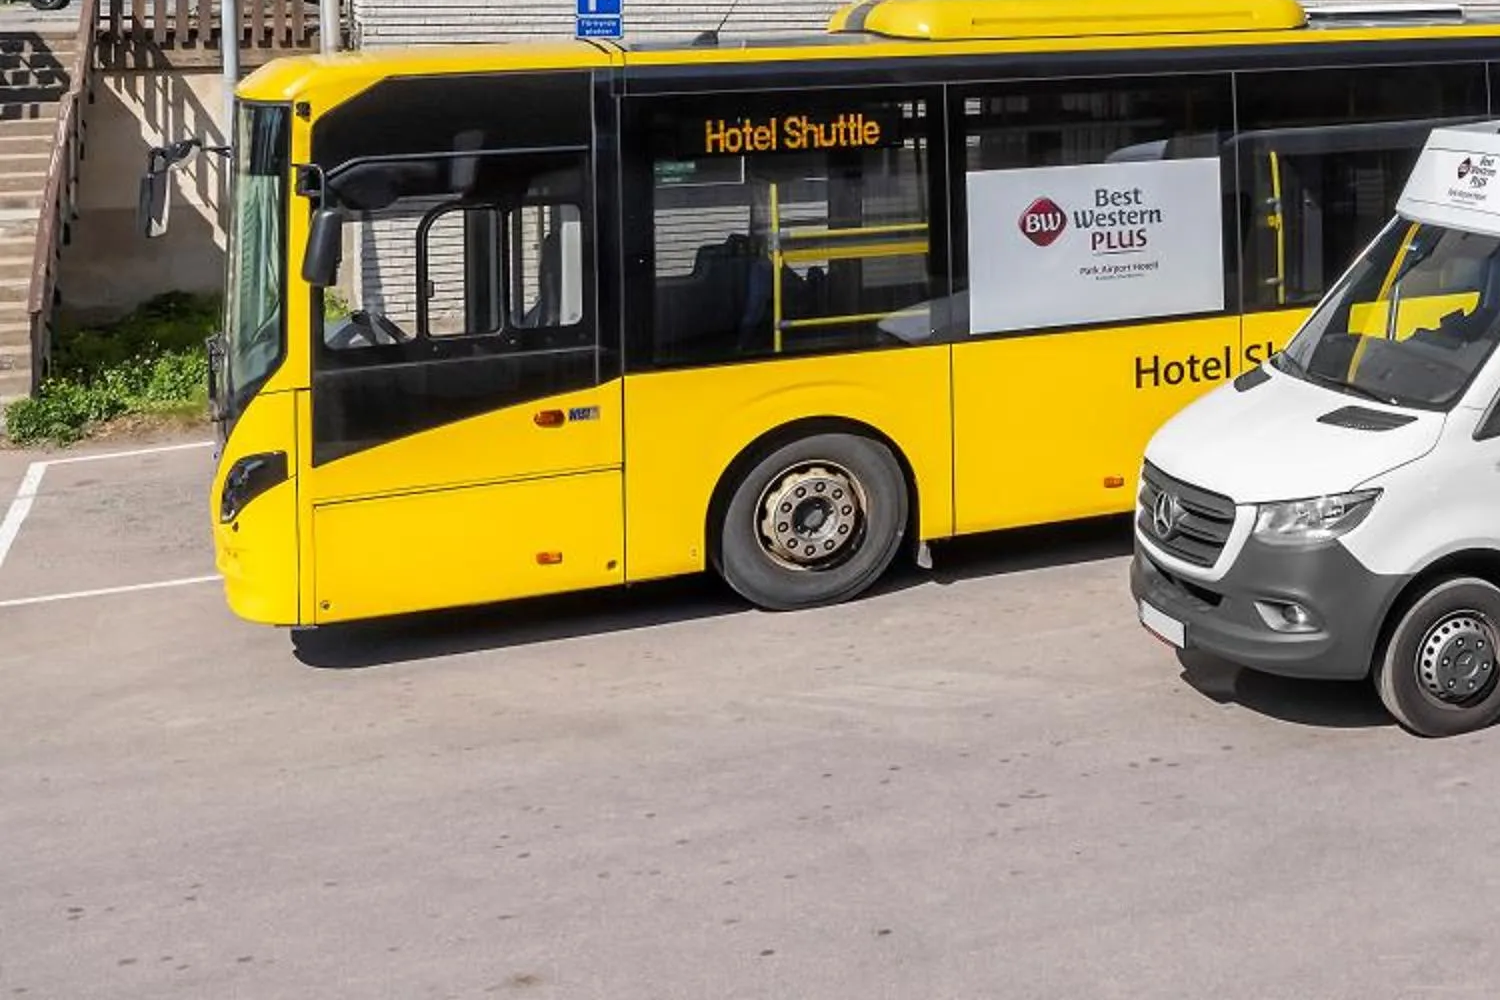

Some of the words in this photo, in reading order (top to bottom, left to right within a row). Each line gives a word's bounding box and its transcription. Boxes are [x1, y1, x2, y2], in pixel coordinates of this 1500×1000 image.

[706, 117, 777, 153] Hotel
[784, 113, 881, 149] Shuttle
[1095, 187, 1143, 207] Best
[1026, 212, 1062, 233] BW
[1073, 208, 1163, 229] Western
[1091, 229, 1147, 251] PLUS
[1135, 346, 1232, 389] Hotel
